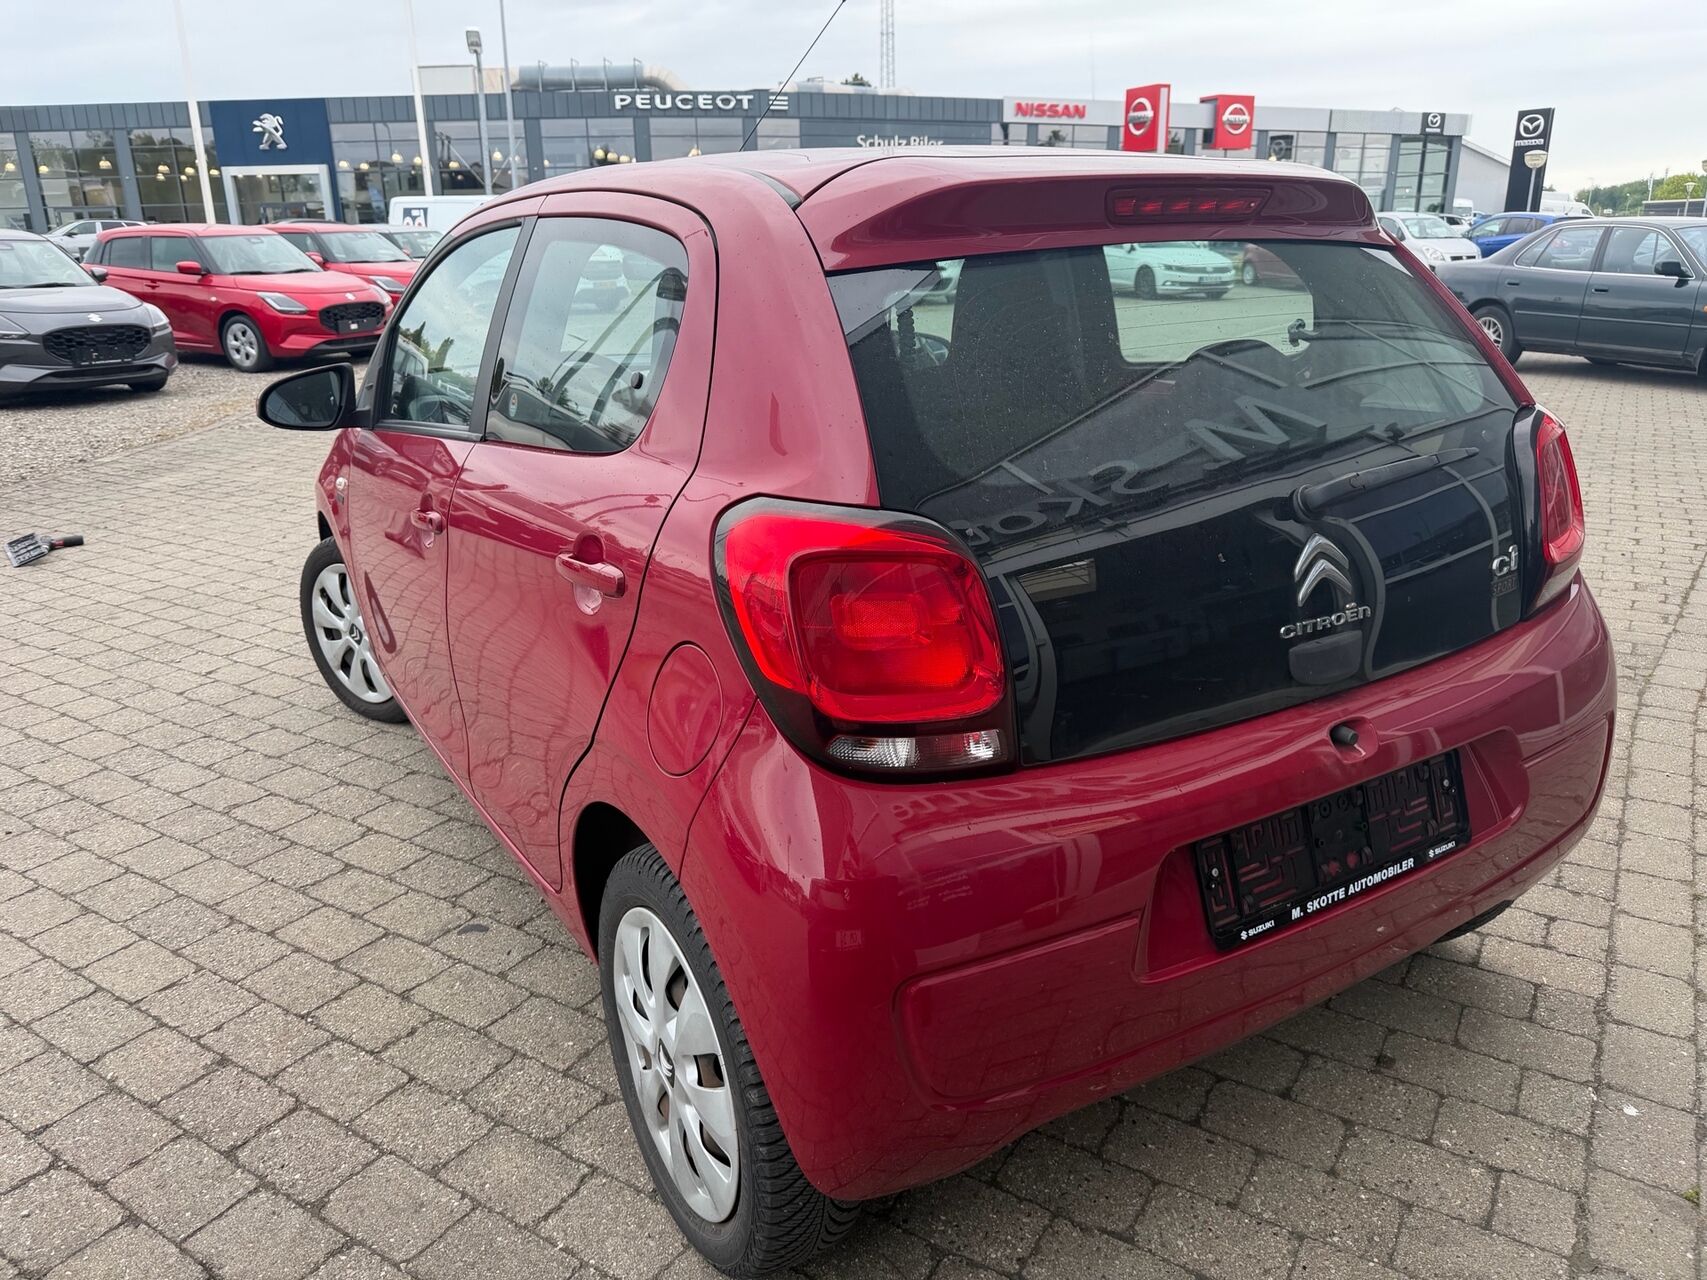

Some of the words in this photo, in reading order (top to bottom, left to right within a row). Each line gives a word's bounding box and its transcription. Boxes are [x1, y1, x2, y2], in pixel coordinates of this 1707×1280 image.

[614, 94, 754, 110] PEUGEOT
[1014, 102, 1086, 119] NISSAN
[856, 134, 907, 147] Schulz
[1434, 841, 1456, 856] SUZUKI
[1291, 907, 1303, 920] M.
[1306, 887, 1346, 913] SKOTTE
[1348, 857, 1415, 896] AUTOMOBILER
[1248, 919, 1275, 937] SUZUKI
